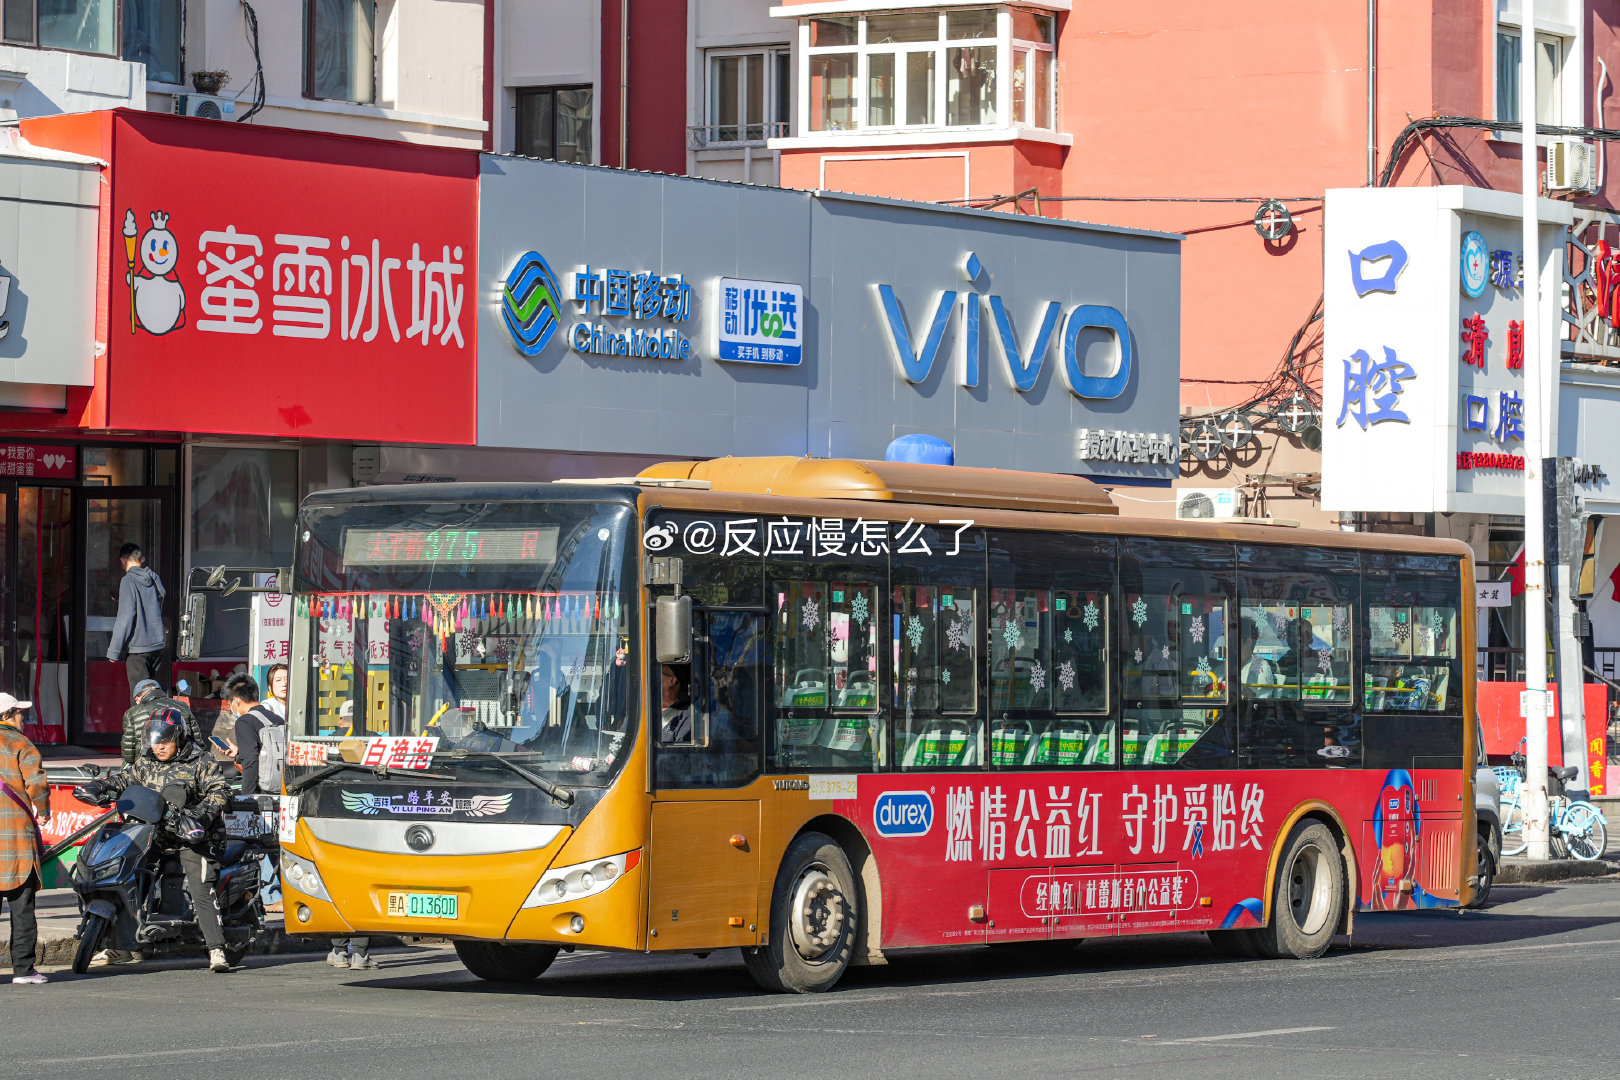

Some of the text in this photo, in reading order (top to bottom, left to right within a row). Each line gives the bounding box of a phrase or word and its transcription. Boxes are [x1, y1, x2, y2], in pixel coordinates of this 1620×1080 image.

[196, 225, 465, 349] 蜜雪冰城
[1491, 249, 1524, 289] 源
[571, 264, 692, 323] 中国移动
[724, 286, 798, 340] 移动 优选
[872, 251, 1132, 400] vivo
[1336, 239, 1417, 431] 口腔
[737, 346, 784, 362] 买手机 到移动
[1462, 390, 1524, 444] 口腔
[7, 446, 35, 460] 我爱你
[1080, 428, 1178, 466] 授权体验中心
[425, 531, 478, 560] 375
[392, 789, 452, 806] 一路平安
[772, 779, 810, 791] YUTONG
[811, 779, 857, 794] 公交375-22
[879, 798, 929, 831] durex
[944, 783, 1265, 862] 燃情公益红 守护爱始终
[388, 894, 456, 916] 黑A 01360D
[1036, 876, 1183, 911] 经典红 杜蕾斯首个公益装
